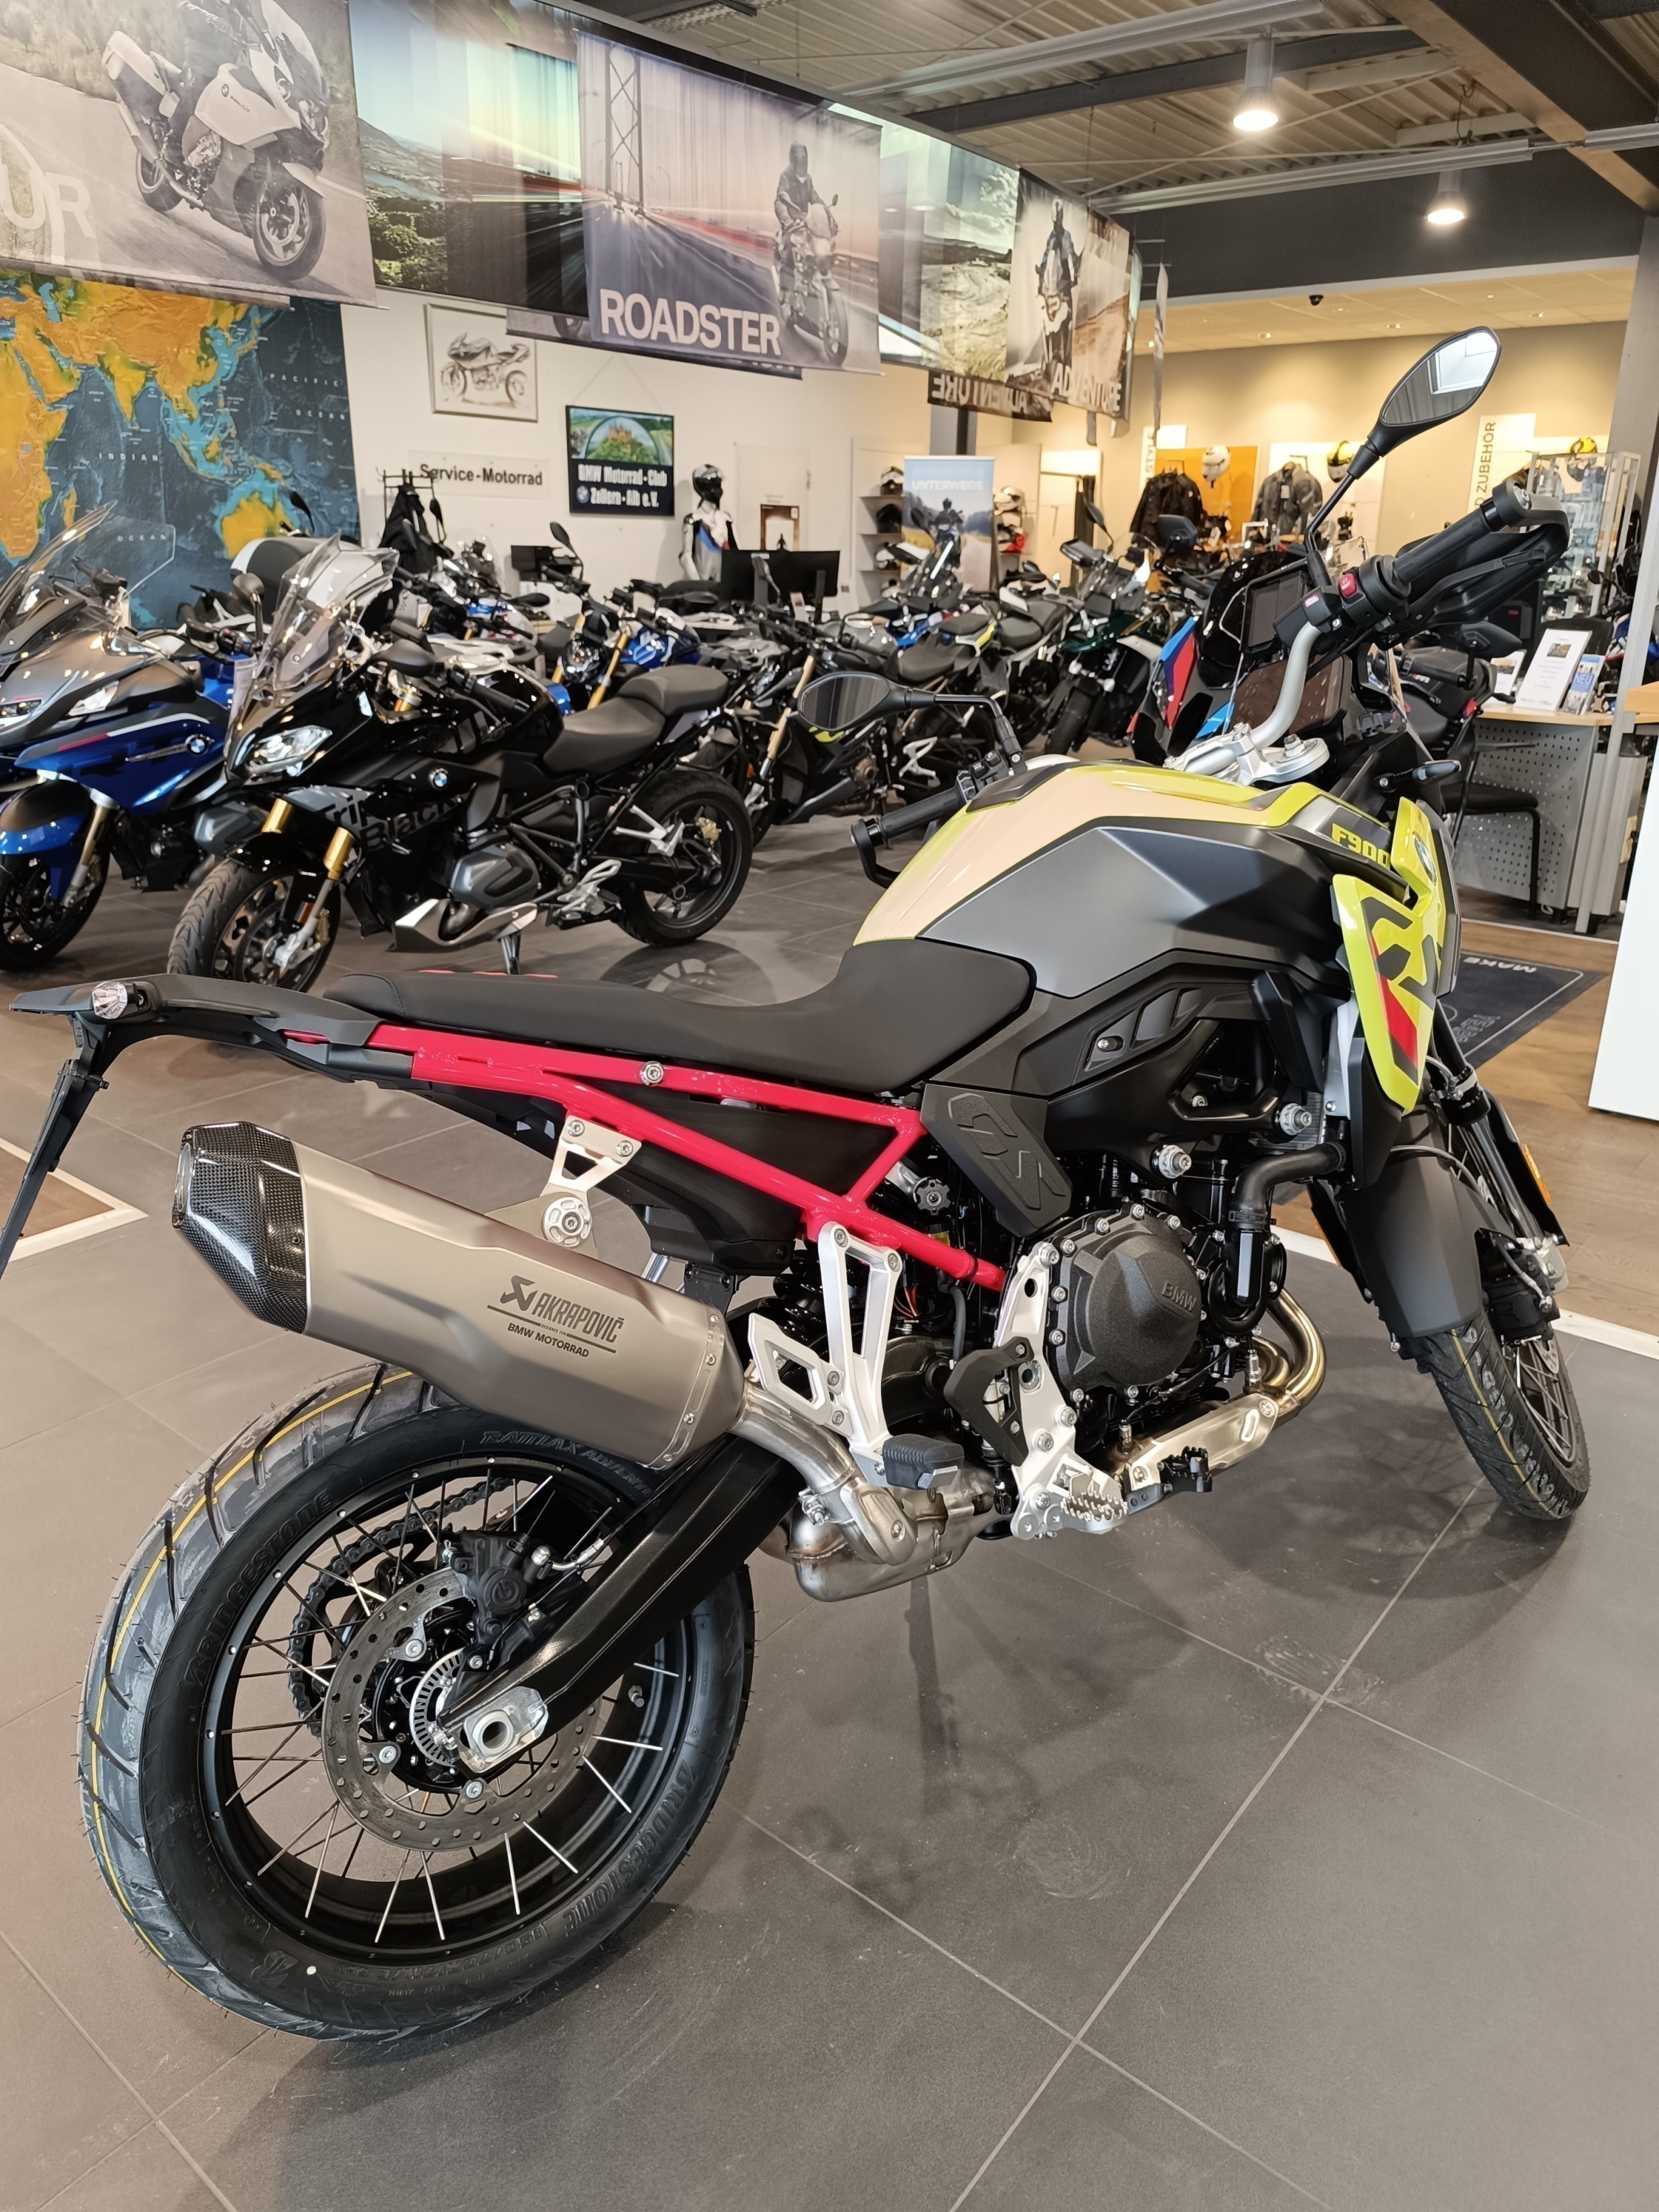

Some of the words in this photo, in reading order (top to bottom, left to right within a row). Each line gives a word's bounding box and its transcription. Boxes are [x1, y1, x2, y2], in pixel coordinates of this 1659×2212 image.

[600, 289, 781, 356] ROADSTER
[269, 373, 339, 387] PACIFIC
[1050, 363, 1123, 412] ADVENTURE
[296, 408, 346, 420] OCEAN
[98, 452, 159, 462] INDIAN
[578, 463, 602, 482] BMW
[1476, 422, 1496, 493] ZUBEHÖR
[912, 479, 984, 491] UNTERWEGS
[117, 534, 167, 542] OCEAN
[1575, 673, 1593, 684] NEU
[1332, 823, 1391, 870] F900
[1463, 957, 1537, 973] MAKE
[1162, 1281, 1197, 1312] BMW
[532, 1292, 625, 1343] AKRAPOVIČ
[507, 1322, 534, 1338] BMW
[535, 1332, 589, 1358] MOTORRAD
[185, 1488, 333, 1686] BRIDGESTONE
[562, 1759, 698, 1937] BRIDGESTONE
